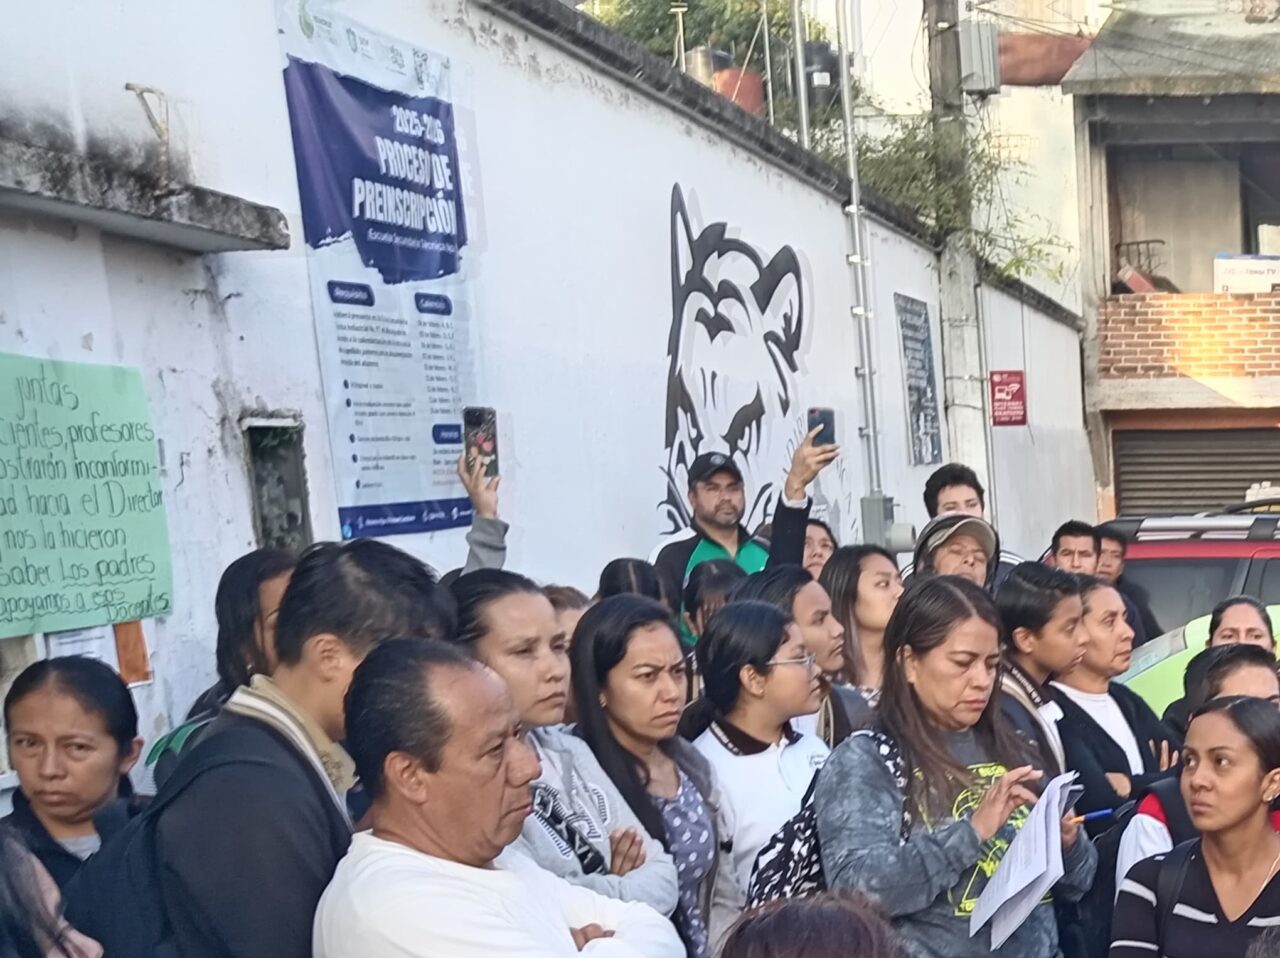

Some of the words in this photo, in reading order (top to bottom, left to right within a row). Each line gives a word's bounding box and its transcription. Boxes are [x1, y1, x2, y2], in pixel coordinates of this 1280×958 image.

[375, 136, 431, 187] PROCESO
[431, 153, 453, 190] DE
[352, 177, 456, 235] PREINSCRIPCIÓN
[16, 362, 79, 421] juntas
[67, 411, 155, 460] profesores
[82, 484, 99, 516] el
[104, 481, 163, 518] Director
[5, 529, 36, 550] nos
[59, 520, 126, 550] hicieron
[60, 557, 89, 580] Los
[96, 548, 155, 586] padres
